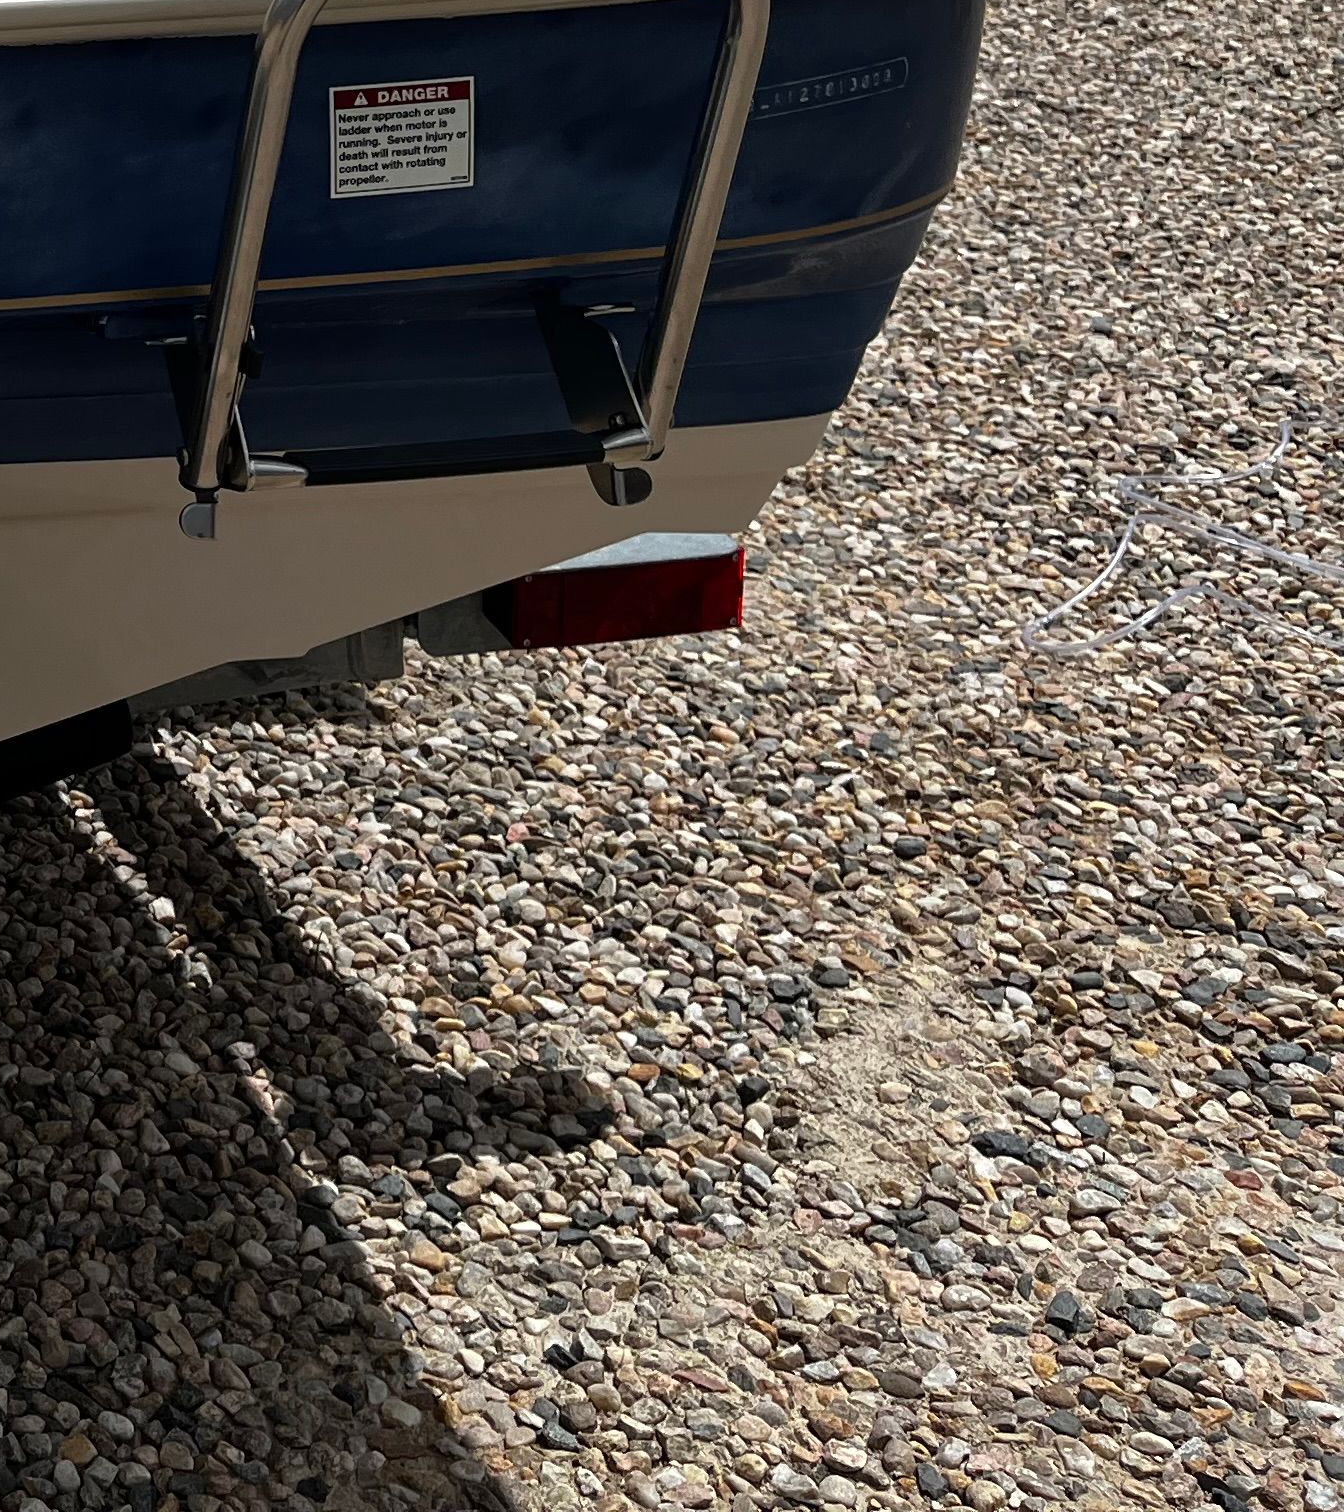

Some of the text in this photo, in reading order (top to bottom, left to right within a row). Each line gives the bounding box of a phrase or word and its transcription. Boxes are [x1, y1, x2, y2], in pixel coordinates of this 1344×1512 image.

[377, 87, 449, 104] DANGER
[338, 106, 456, 124] Never approach or use
[338, 118, 448, 136] ladder when motor is
[338, 131, 467, 149] running. Severe injury or
[338, 143, 448, 162] death will result from
[339, 156, 446, 174] contact with rotating
[338, 174, 389, 188] propeller.
